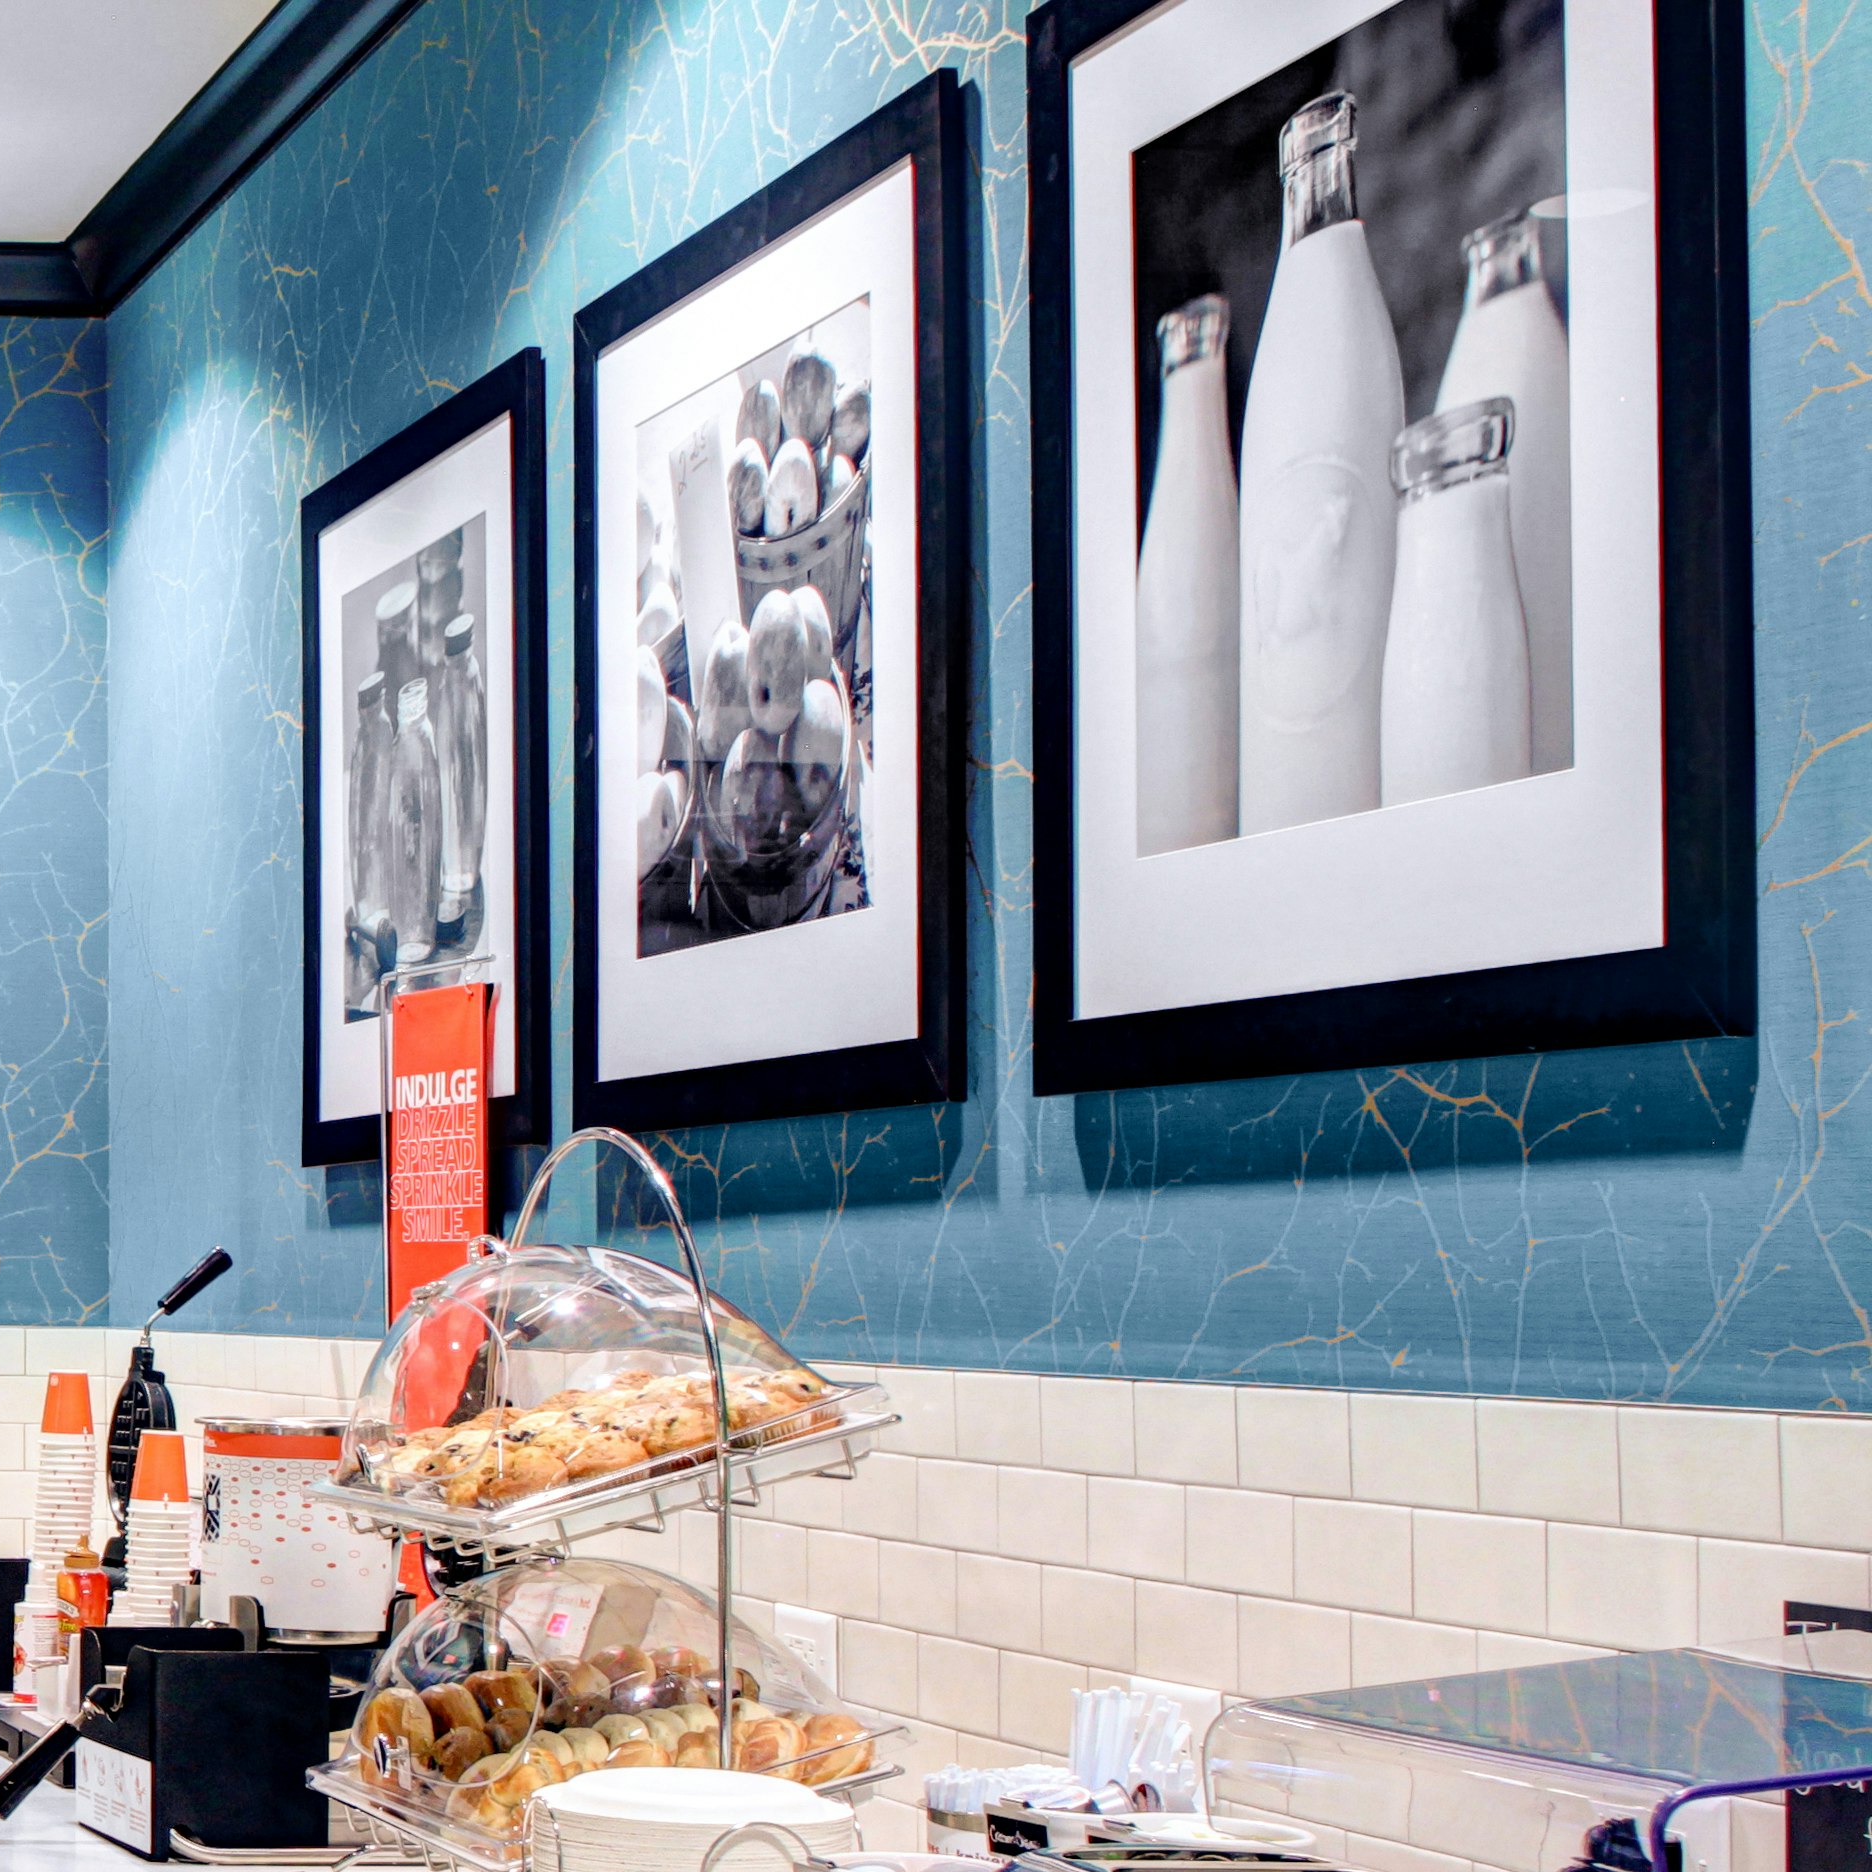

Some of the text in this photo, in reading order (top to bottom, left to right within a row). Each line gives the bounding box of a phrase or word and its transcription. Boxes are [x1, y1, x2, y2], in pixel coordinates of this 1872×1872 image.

[396, 1068, 477, 1110] INDULGE
[397, 1103, 477, 1141] DRIZZLE
[396, 1137, 477, 1174] SPREAD
[391, 1170, 484, 1210] SPRINKLE
[402, 1206, 470, 1243] SMILE.
